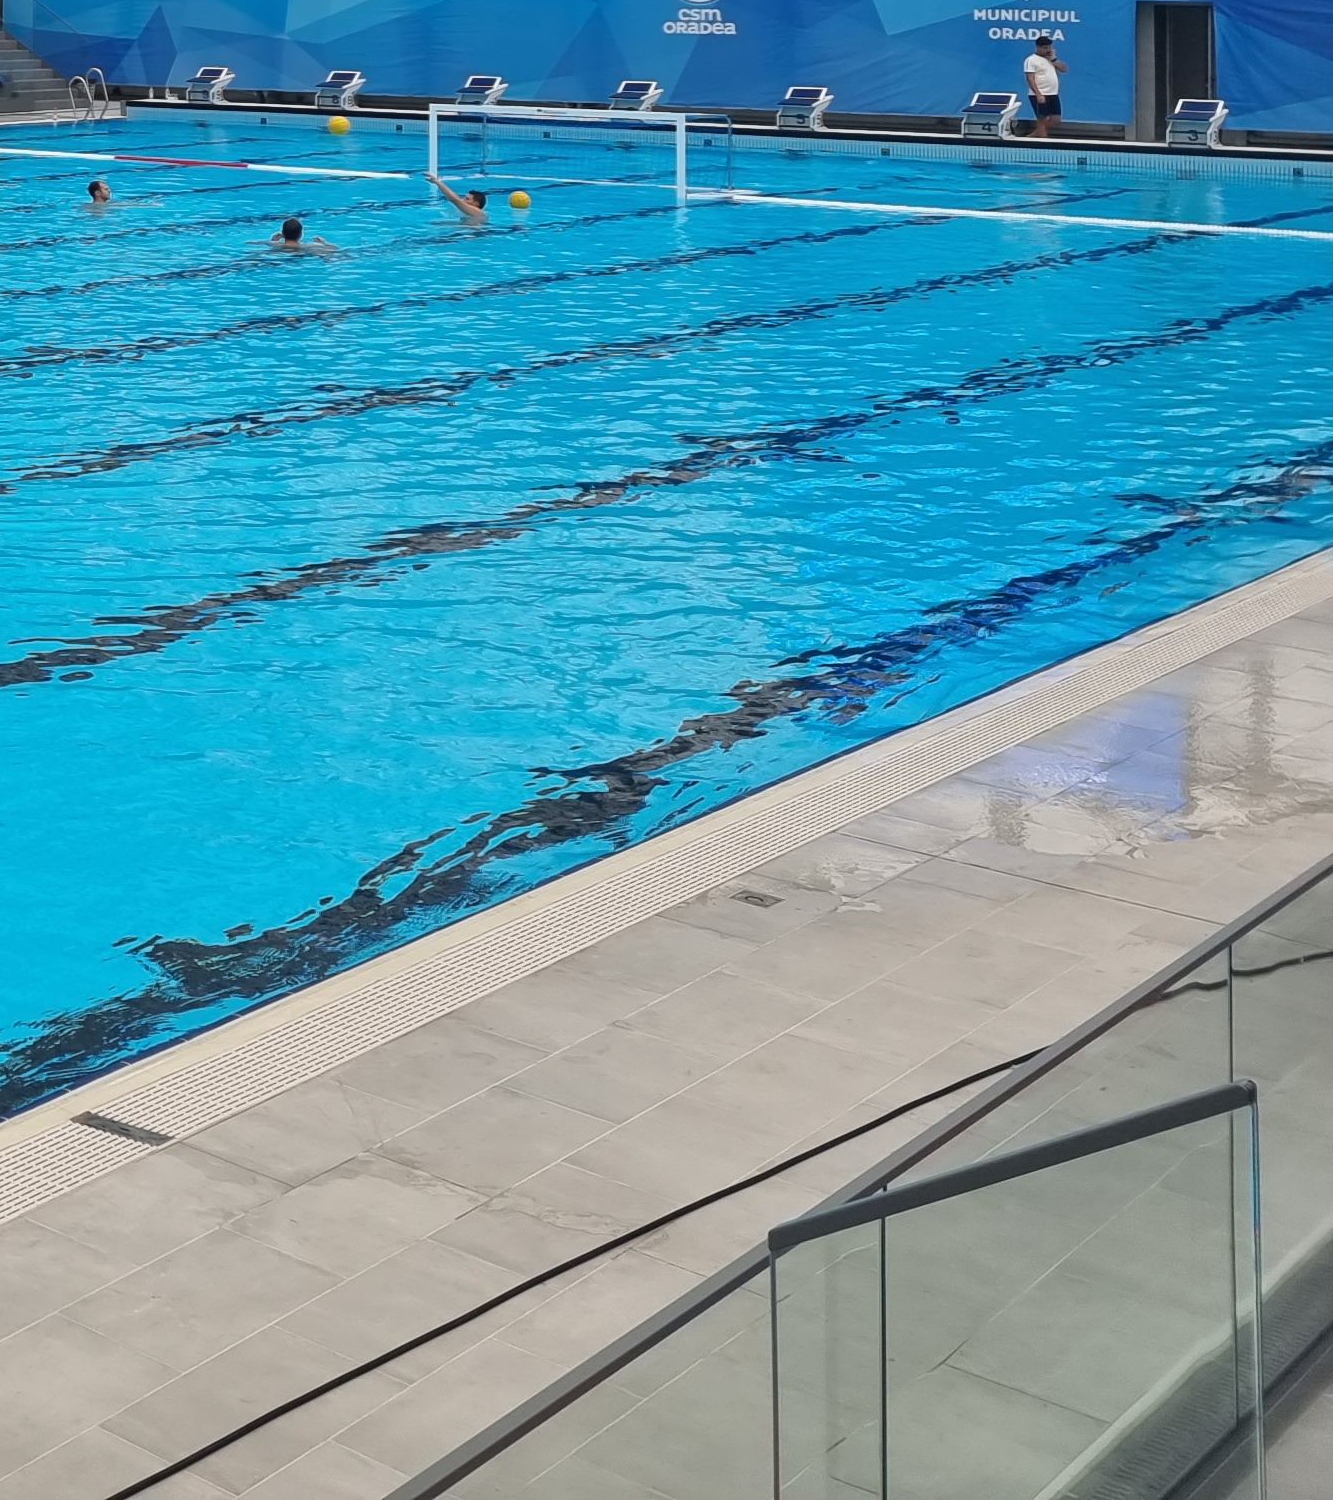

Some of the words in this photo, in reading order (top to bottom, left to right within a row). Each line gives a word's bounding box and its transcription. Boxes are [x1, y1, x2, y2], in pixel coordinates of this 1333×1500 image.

[973, 8, 1081, 23] MUNICIPIUL
[982, 122, 992, 132] 4
[1188, 130, 1199, 141] 3
